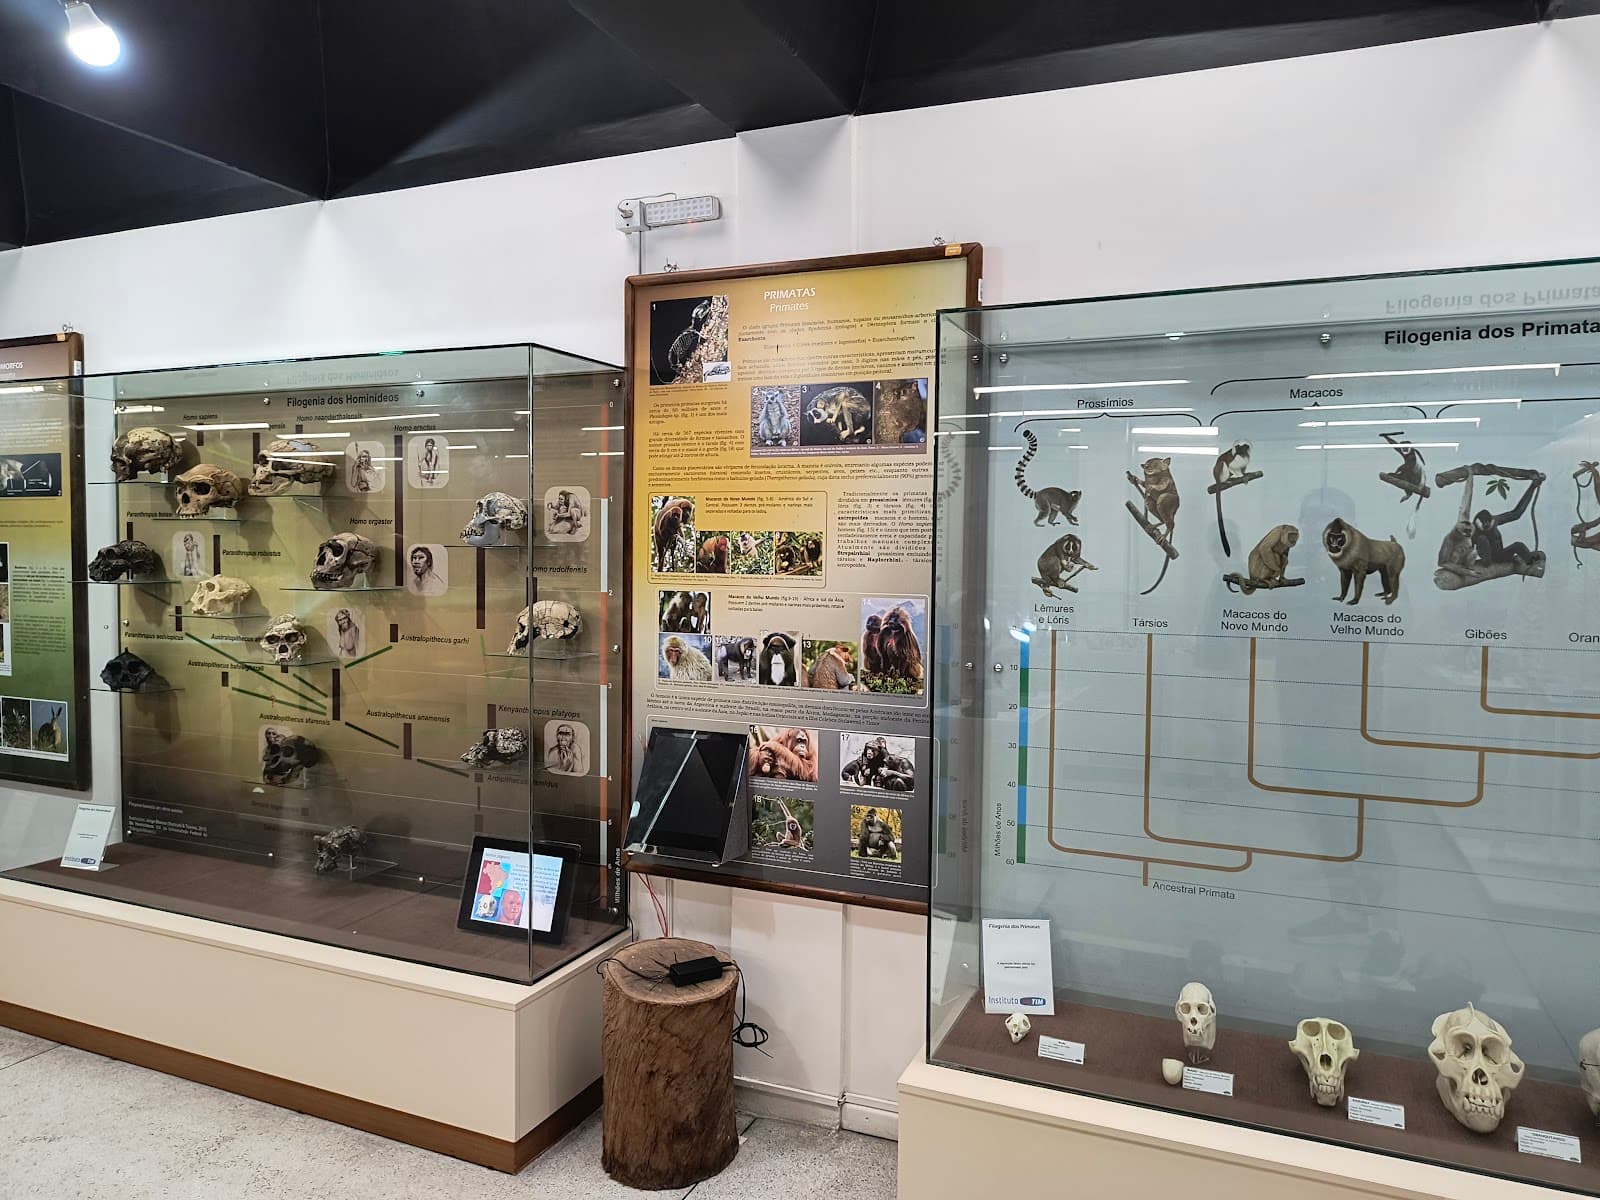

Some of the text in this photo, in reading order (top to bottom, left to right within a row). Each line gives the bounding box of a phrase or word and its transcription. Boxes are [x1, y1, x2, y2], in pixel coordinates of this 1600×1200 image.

[764, 287, 816, 300] PRIMATAS
[769, 302, 809, 313] Primates
[1384, 319, 1600, 346] Filogenia dos Primata
[1289, 387, 1344, 400] Macacos
[287, 393, 400, 408] Filogenia dos Hominídeos
[1077, 397, 1134, 410] Prossímios
[368, 518, 393, 526] ergaster
[222, 549, 257, 557] Paranthropus
[550, 565, 587, 574] rudolfensis
[1034, 603, 1074, 615] Lêmures
[1223, 609, 1288, 621] Macacos do
[1047, 614, 1070, 625] Lóris
[1132, 618, 1168, 628] Társios
[1333, 612, 1402, 624] Macacos do
[1221, 621, 1289, 633] Novo Mundo
[1330, 624, 1405, 637] Velho Mundo
[400, 634, 470, 646] Australopithecus garhi
[1464, 628, 1508, 641] Gibões
[1568, 632, 1600, 643] Oran
[366, 709, 451, 723] Australopithecus anamensis
[498, 704, 580, 720] Kenyanthopus platyops
[259, 713, 304, 724] Australopithecus
[995, 820, 1001, 830] de
[1152, 881, 1236, 901] Ancestral Primata
[989, 996, 1019, 1005] Instituto
